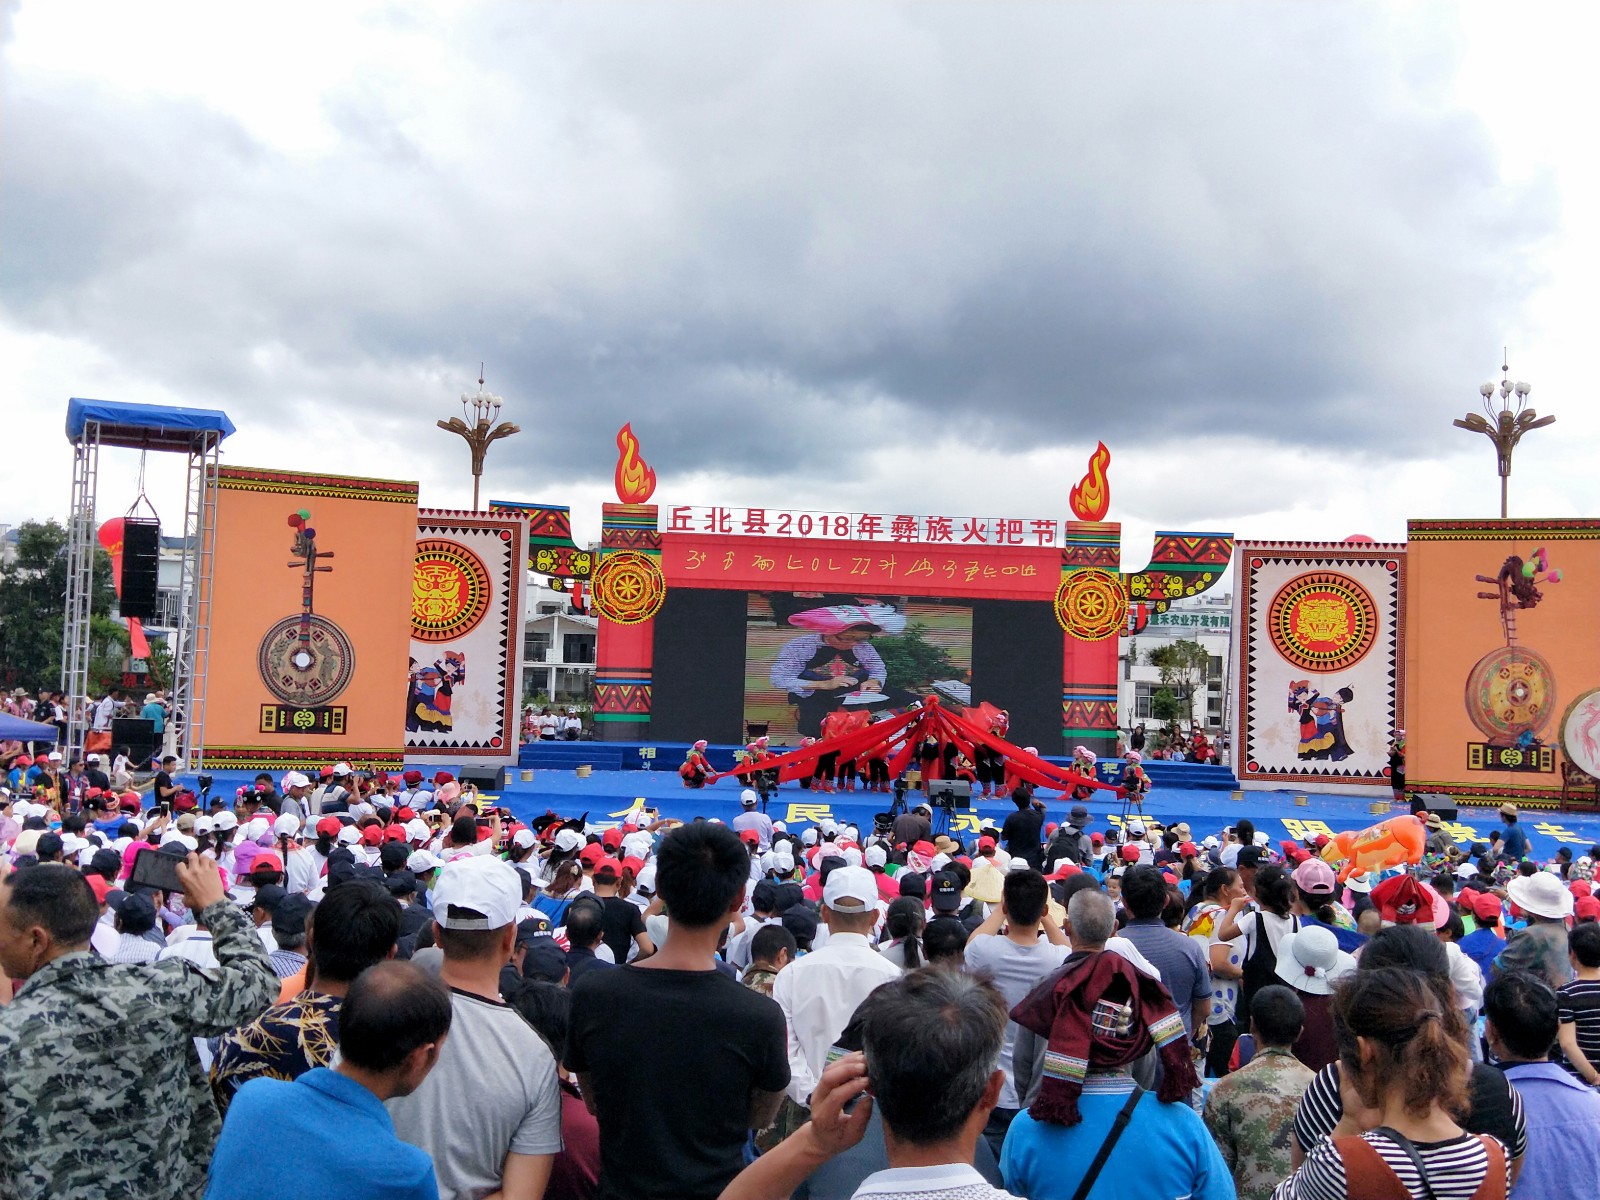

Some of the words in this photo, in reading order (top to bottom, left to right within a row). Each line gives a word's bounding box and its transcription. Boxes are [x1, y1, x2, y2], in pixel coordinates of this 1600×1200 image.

[667, 506, 1057, 546] 丘北县2018年彝族火把节
